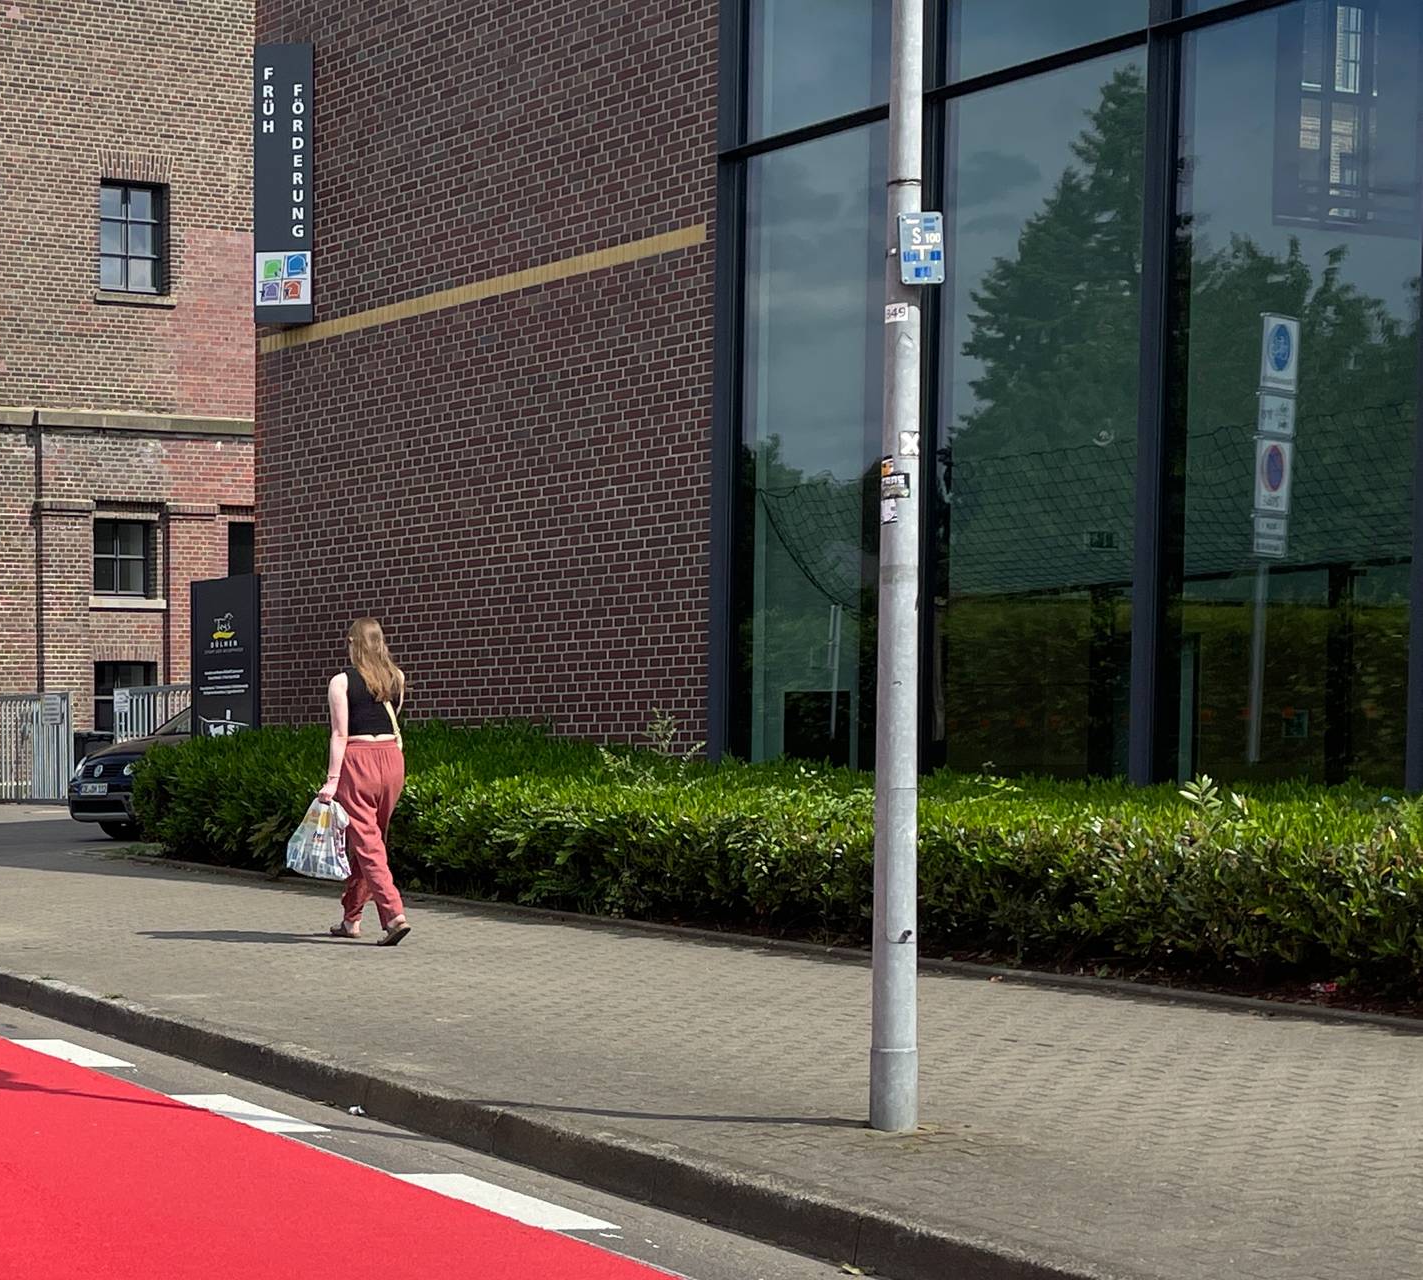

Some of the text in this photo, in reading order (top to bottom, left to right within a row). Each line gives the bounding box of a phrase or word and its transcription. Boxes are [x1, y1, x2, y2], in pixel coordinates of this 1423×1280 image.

[262, 66, 275, 133] FRÜH
[291, 83, 305, 238] FÖRDERUNG
[912, 227, 941, 244] S 100
